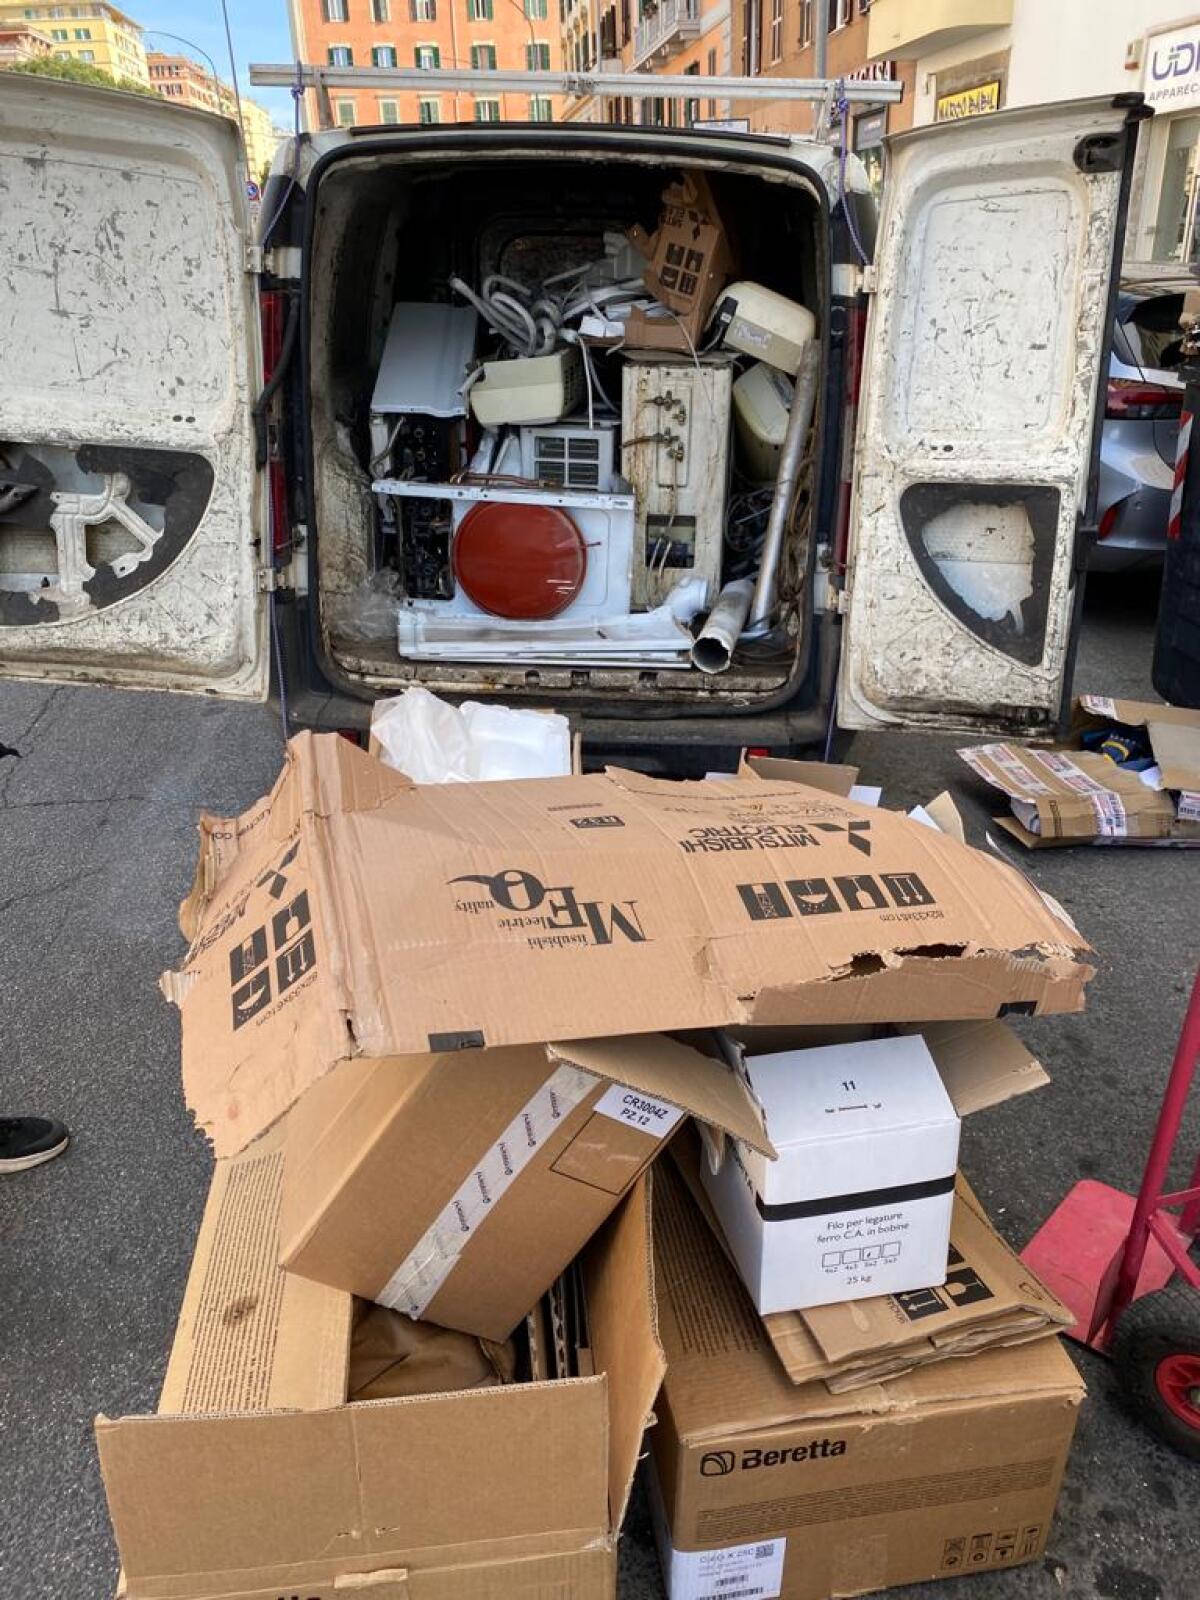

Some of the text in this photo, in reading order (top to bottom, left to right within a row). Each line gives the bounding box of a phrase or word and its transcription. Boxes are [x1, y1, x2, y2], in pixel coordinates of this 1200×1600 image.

[688, 823, 808, 838] ELECTRIC
[679, 833, 821, 853] MITSUBISHI
[842, 1080, 856, 1091] 11
[827, 1213, 903, 1230] Filo per legature
[817, 1223, 909, 1244] ferro C.A. in bobine
[742, 1438, 847, 1470] Beretta
